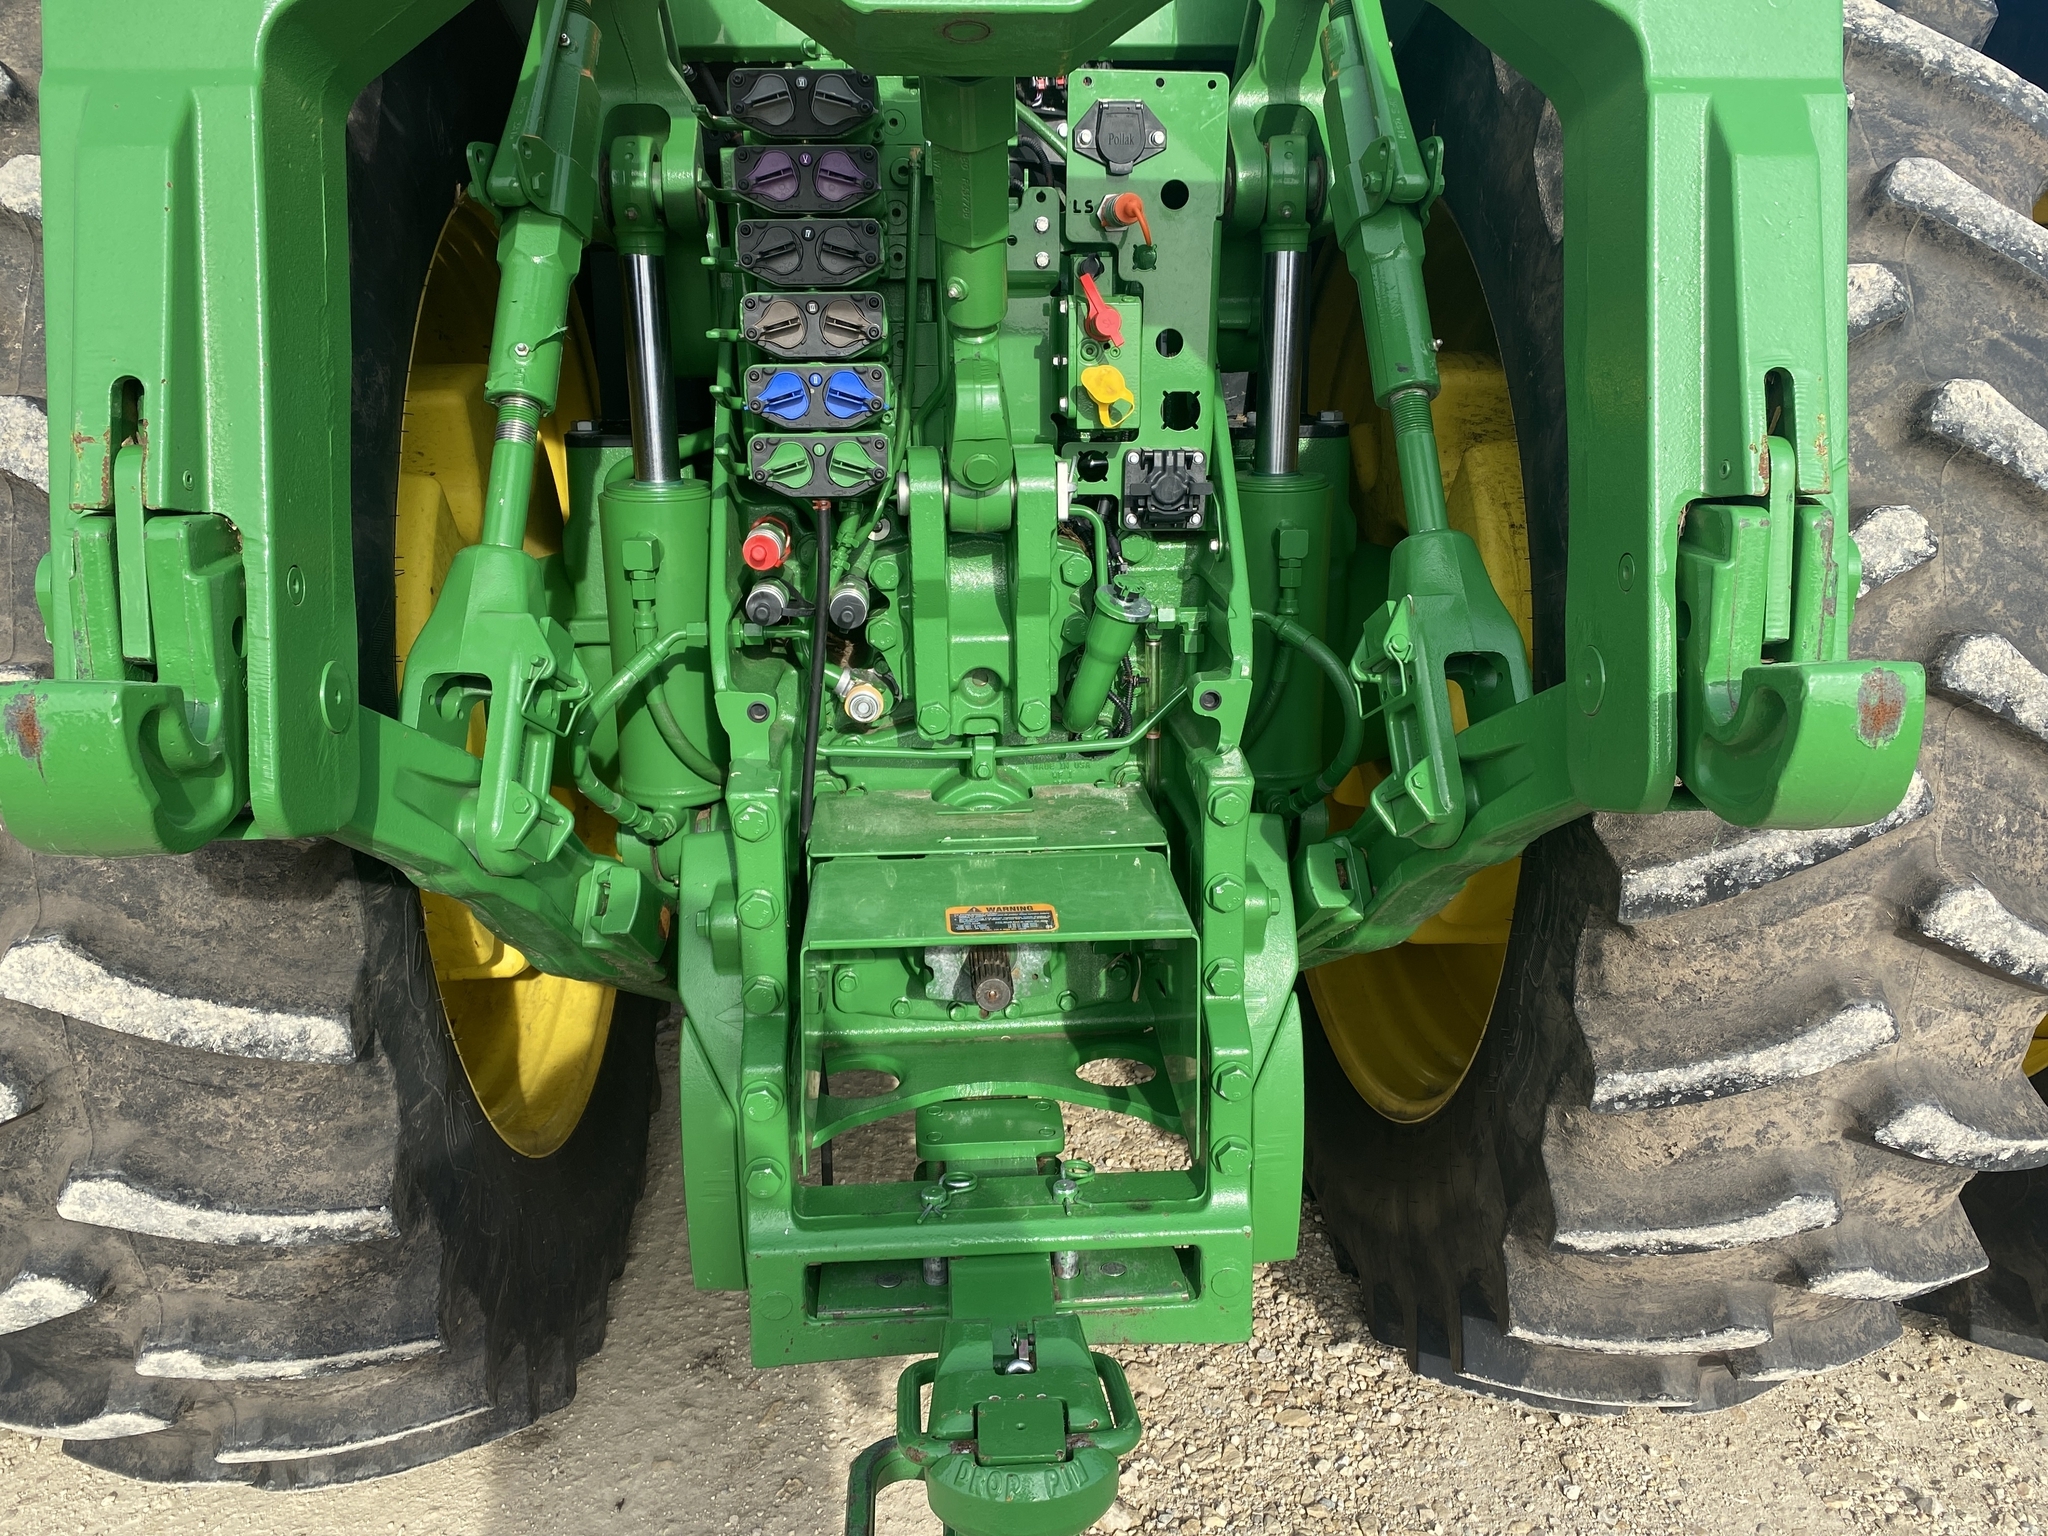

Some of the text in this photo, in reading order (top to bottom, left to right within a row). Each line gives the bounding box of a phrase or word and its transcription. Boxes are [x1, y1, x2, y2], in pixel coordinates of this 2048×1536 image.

[1108, 132, 1135, 146] Pollak
[802, 154, 809, 164] V
[1073, 199, 1094, 214] LS
[1033, 761, 1091, 770] MADE IN USA
[1043, 1457, 1090, 1500] PIN
